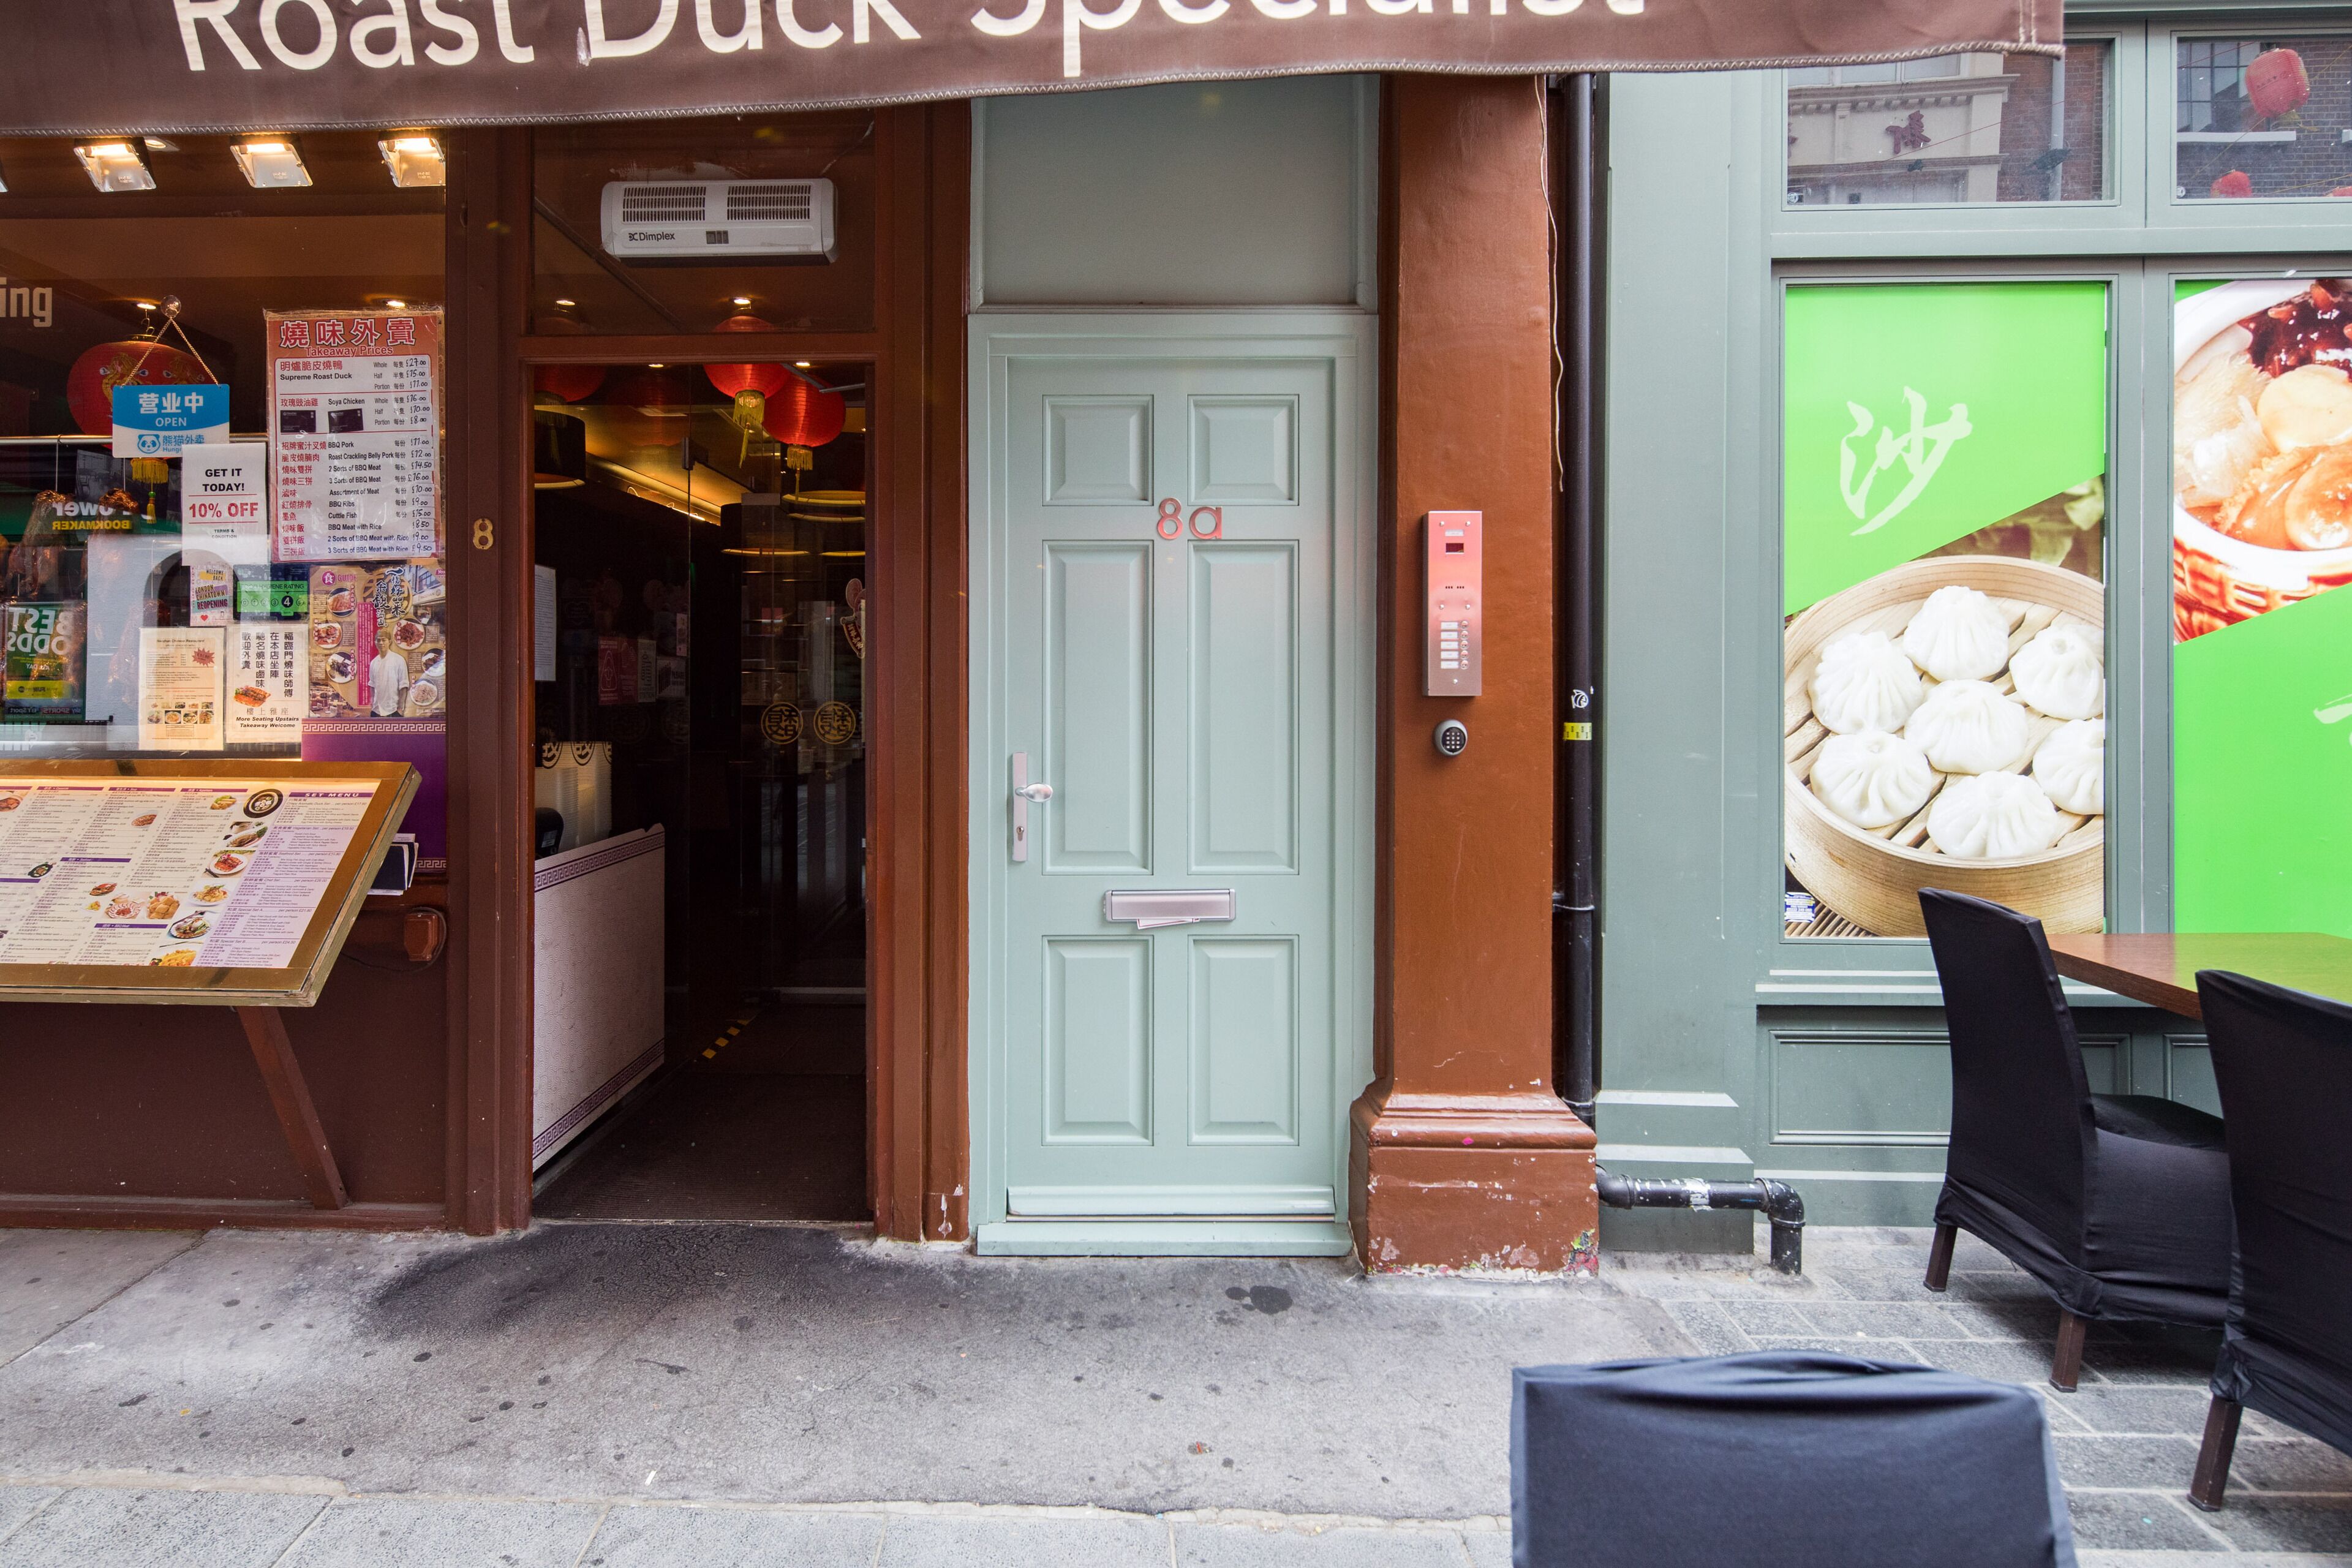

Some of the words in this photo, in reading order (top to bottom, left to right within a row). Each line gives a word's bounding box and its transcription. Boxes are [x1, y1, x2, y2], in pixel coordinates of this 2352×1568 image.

[172, 0, 535, 72] Roast
[639, 232, 676, 242] Dimplex
[279, 317, 415, 348] 燒味外賣
[305, 347, 356, 357] Takeaway
[360, 345, 393, 355] Prices
[138, 392, 203, 414] 营业中
[156, 417, 187, 427] OPEN
[163, 434, 205, 447] 熊猫外卖
[1839, 385, 1973, 537] 沙
[202, 483, 244, 492] TODAY!
[189, 503, 222, 518] 10%
[228, 502, 258, 517] OFF
[1156, 497, 1223, 540] 8a
[472, 517, 494, 551] 8
[195, 585, 215, 594] LONDON
[196, 590, 225, 601] CHINATOWN
[197, 598, 228, 609] REOPENING
[284, 597, 290, 606] 4
[270, 632, 279, 679] 在本店坐陣
[284, 632, 293, 698] 福臨門燒味師傅
